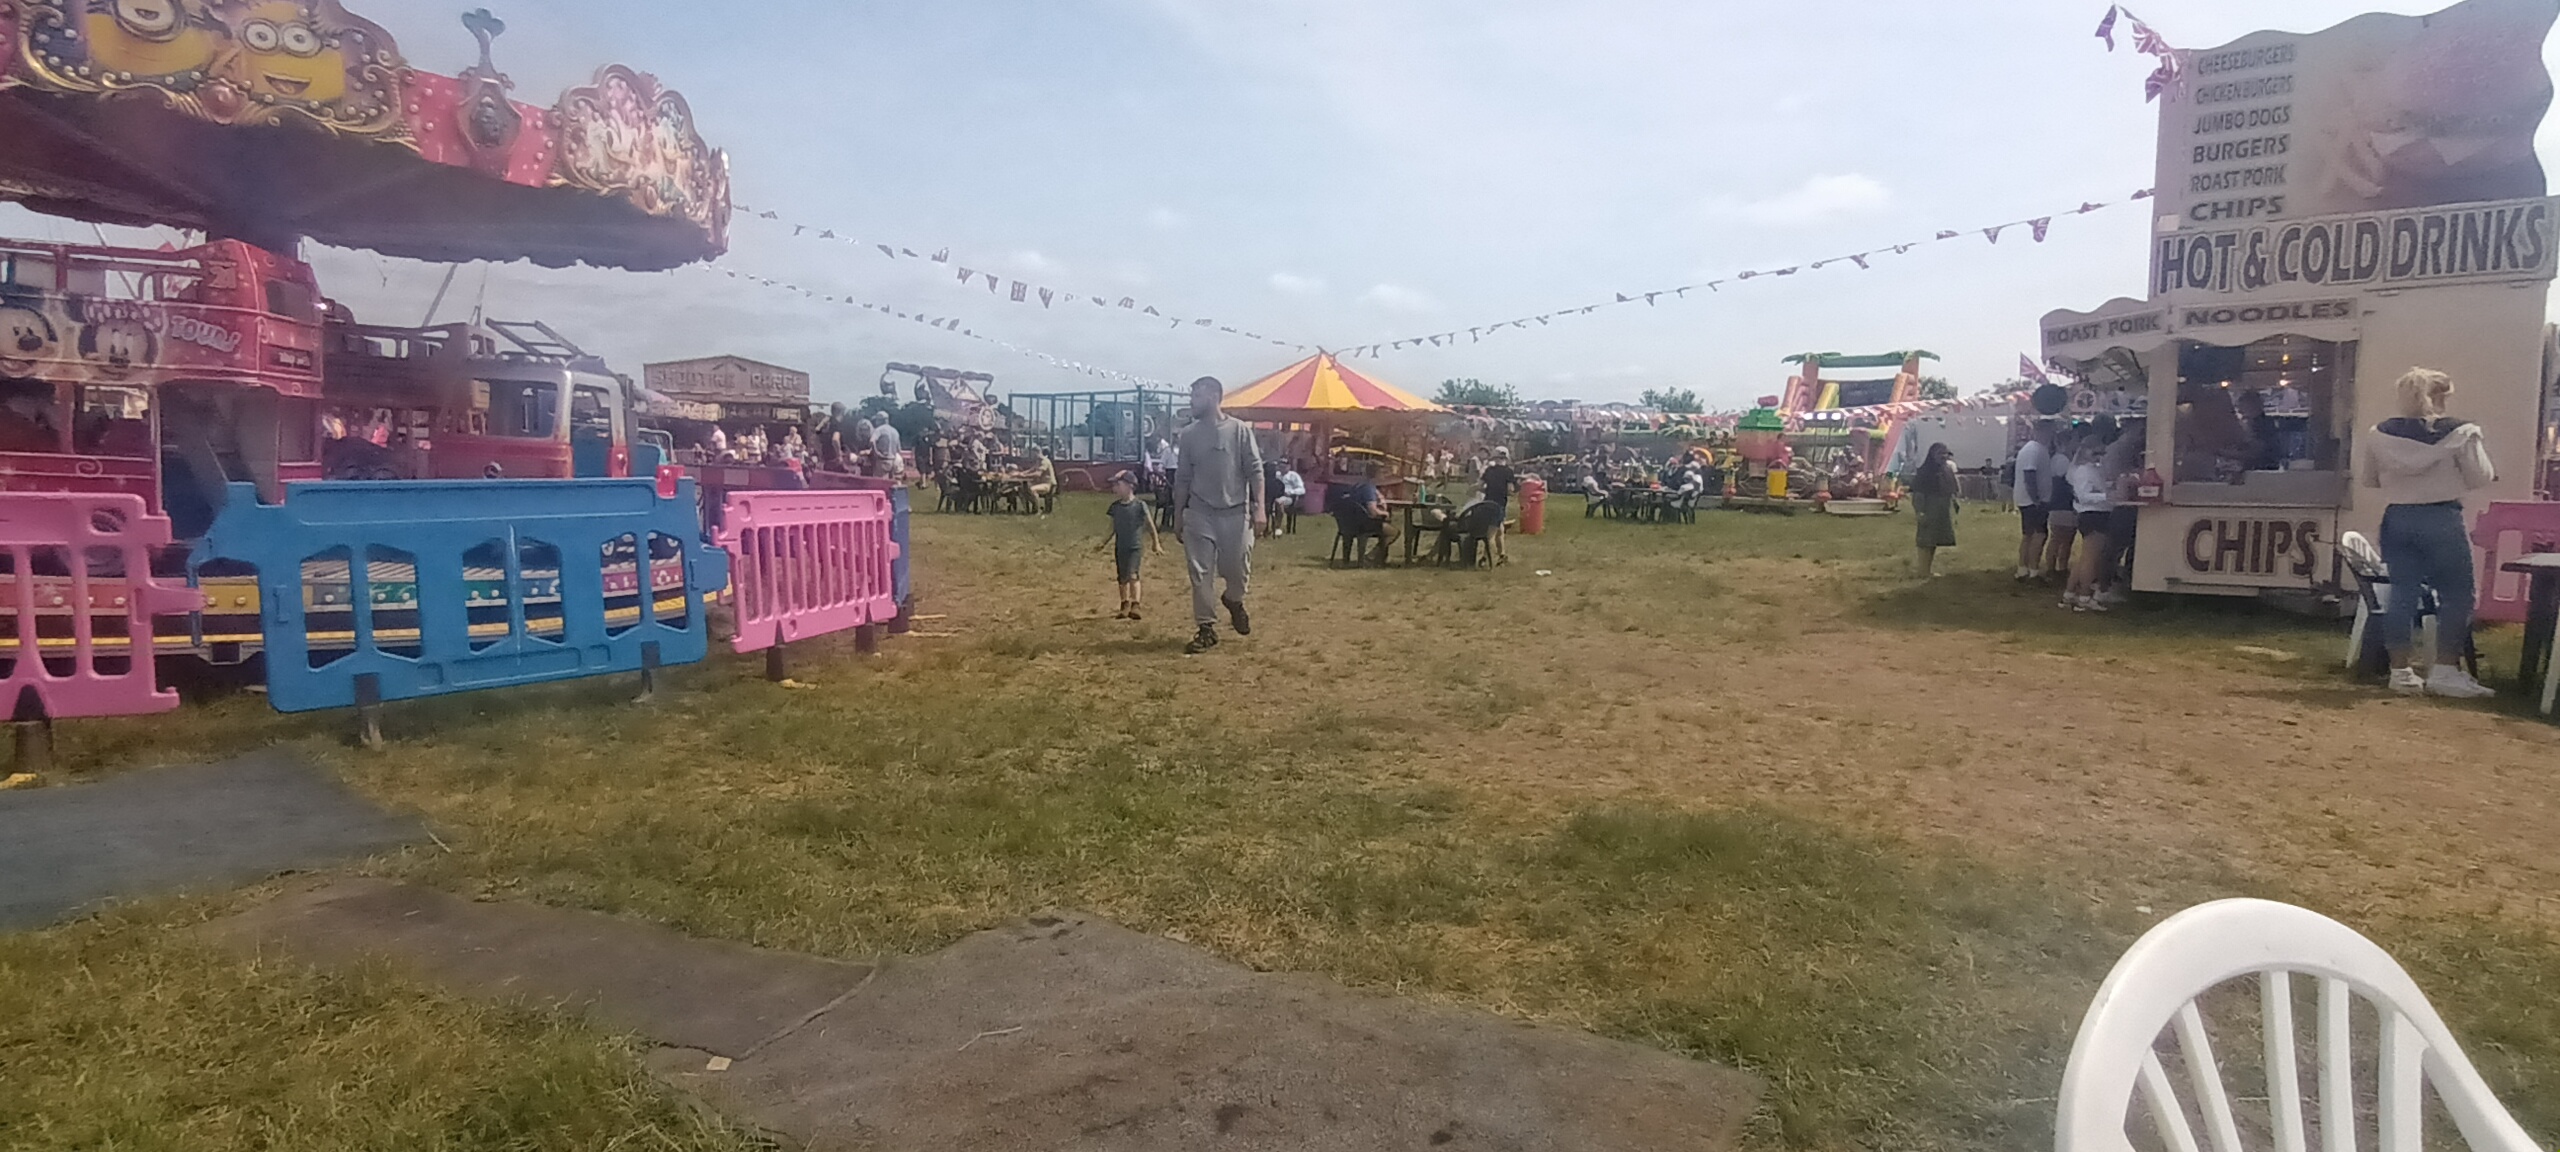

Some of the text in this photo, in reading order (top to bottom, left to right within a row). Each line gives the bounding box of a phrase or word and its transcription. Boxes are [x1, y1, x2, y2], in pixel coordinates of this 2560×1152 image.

[2198, 43, 2296, 75] CHEESEBURGERS
[2193, 105, 2291, 134] JUMBO DOGS
[2193, 133, 2291, 164] BURGERS
[2190, 164, 2288, 193] ROAST PORK
[2189, 195, 2286, 221] CHIPS
[2160, 204, 2545, 294] HOT & COLD DRINKS
[2186, 302, 2350, 325] NOODLES
[2046, 314, 2161, 346] ROAST PORK
[2186, 518, 2317, 576] CHIPS
